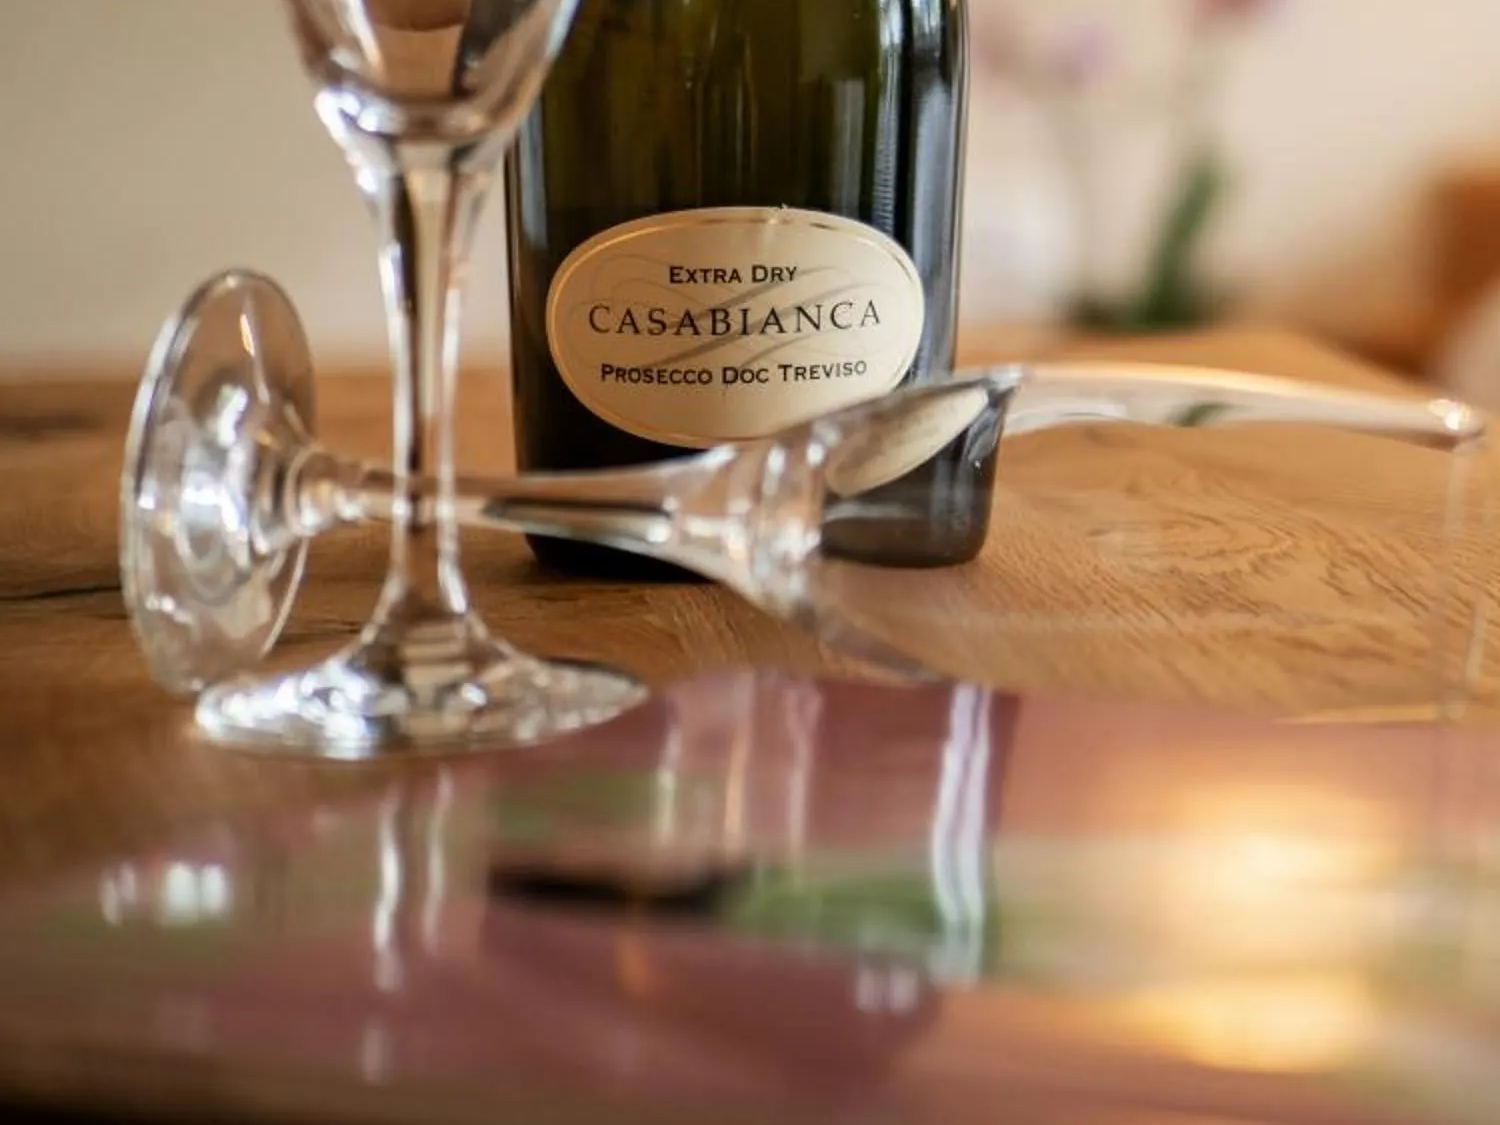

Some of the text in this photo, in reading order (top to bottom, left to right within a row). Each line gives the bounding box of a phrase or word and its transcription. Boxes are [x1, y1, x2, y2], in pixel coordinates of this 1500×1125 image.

[669, 264, 798, 284] EXTRA DRY
[588, 299, 882, 336] CASABIANCA
[600, 360, 867, 384] PROSECCO DOC TREVISO
